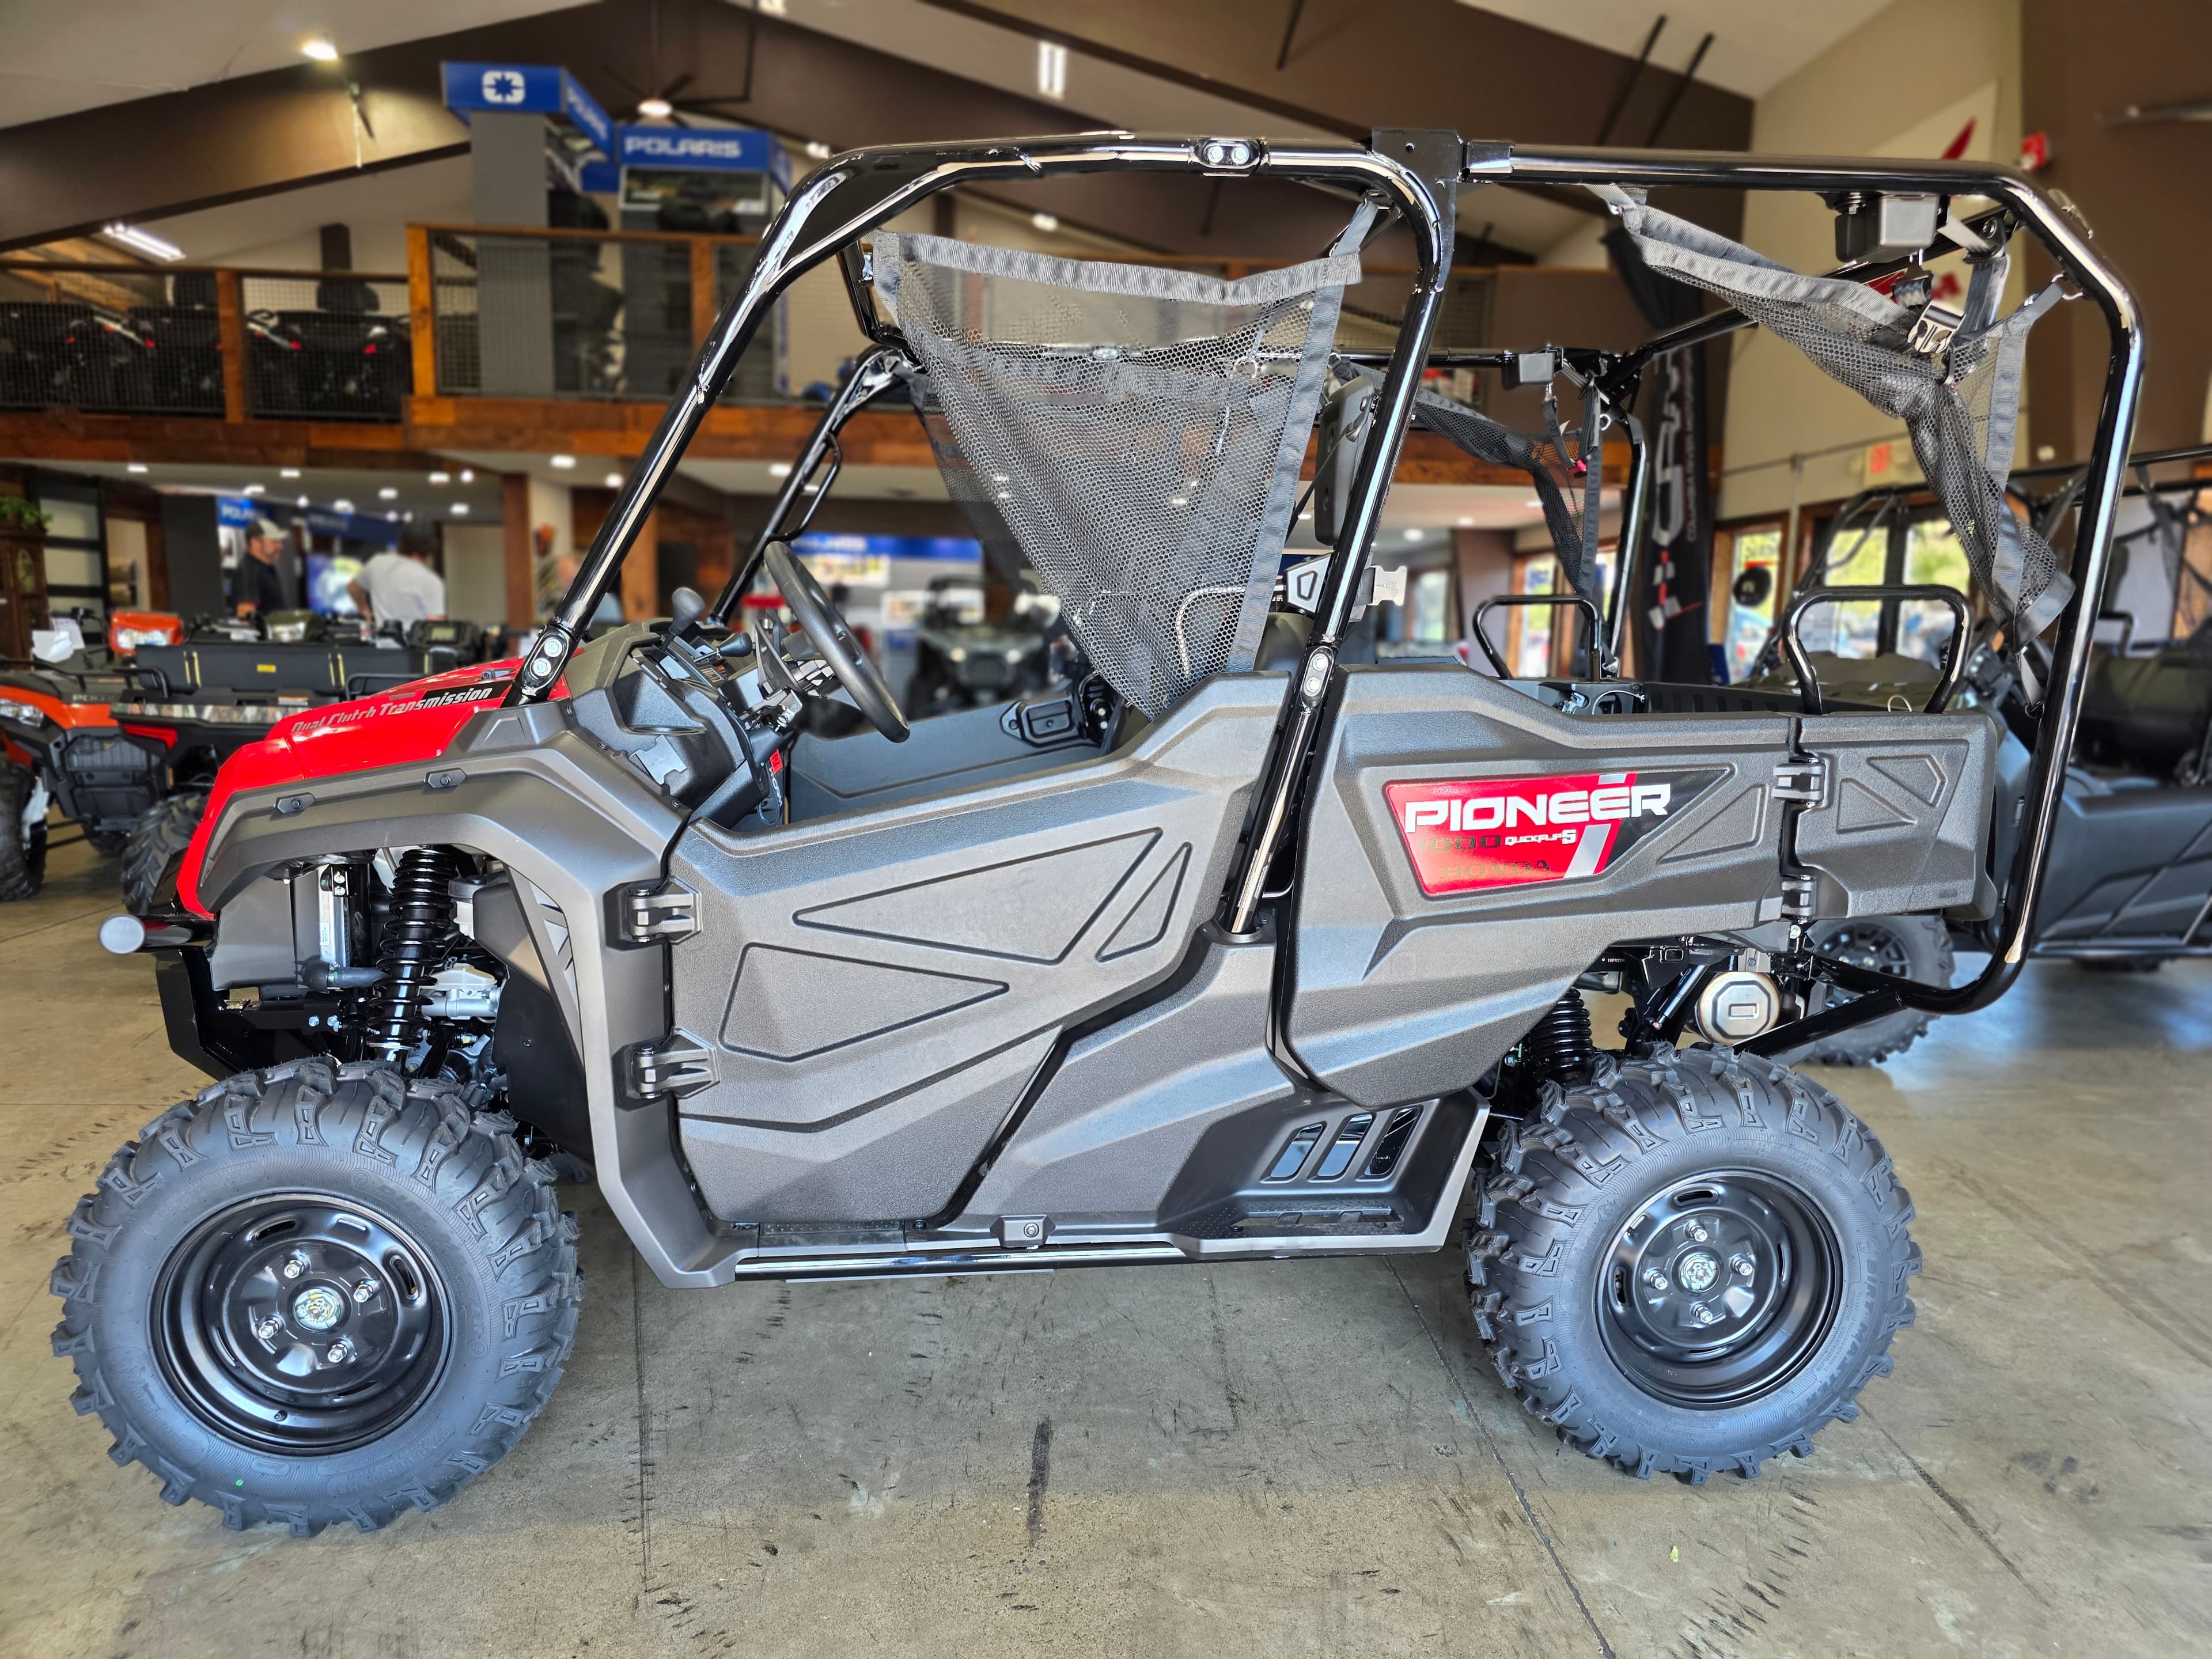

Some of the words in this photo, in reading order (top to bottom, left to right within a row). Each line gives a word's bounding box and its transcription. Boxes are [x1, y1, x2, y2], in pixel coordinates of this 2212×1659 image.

[625, 137, 741, 158] POLARIS
[328, 706, 376, 725] Clutch
[380, 687, 493, 716] Transmission
[1404, 784, 1670, 833] PIONEER
[1415, 834, 1500, 853] 1000
[1441, 859, 1552, 879] HONDA
[1862, 1257, 1877, 1315] DIRT
